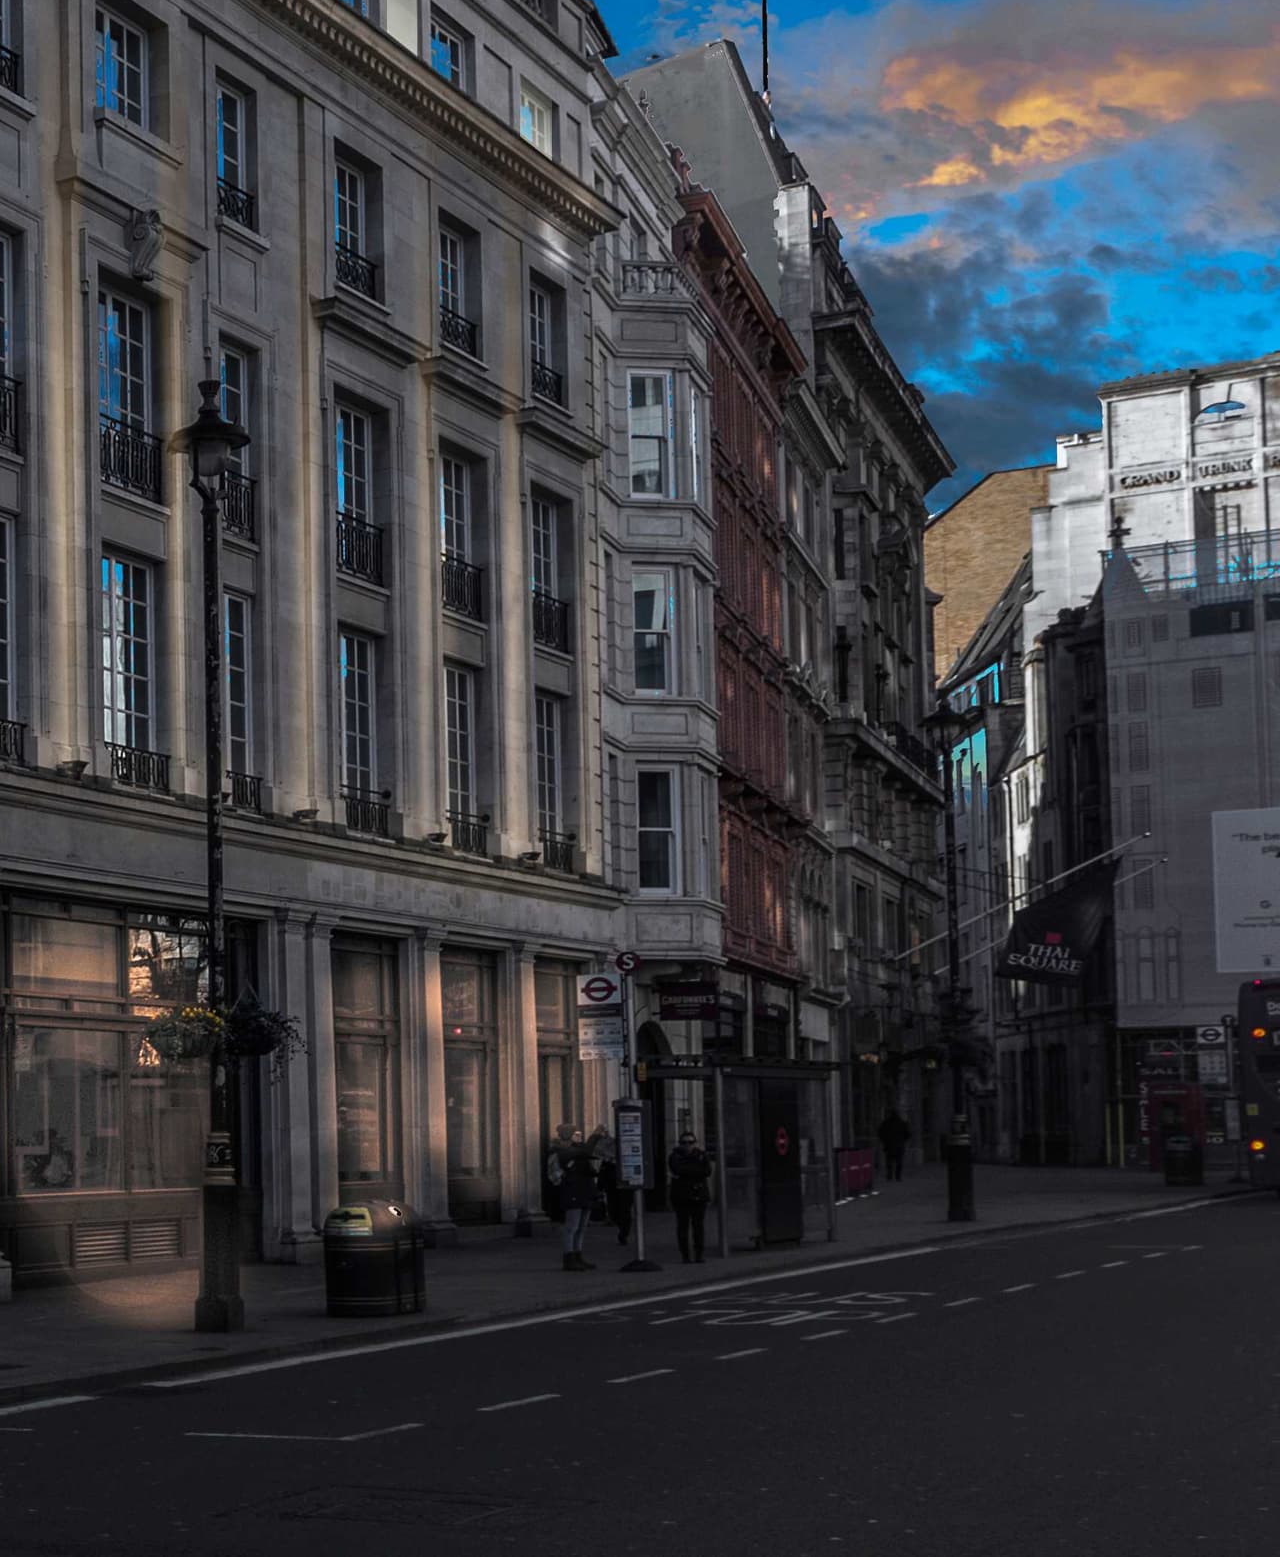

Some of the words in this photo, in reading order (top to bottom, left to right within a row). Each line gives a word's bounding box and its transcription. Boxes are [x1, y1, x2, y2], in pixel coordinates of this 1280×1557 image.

[1120, 470, 1181, 489] GRAND
[1198, 458, 1253, 478] TRUNK
[1027, 943, 1071, 959] THAI
[622, 953, 636, 970] S
[1007, 952, 1084, 972] SQUARE
